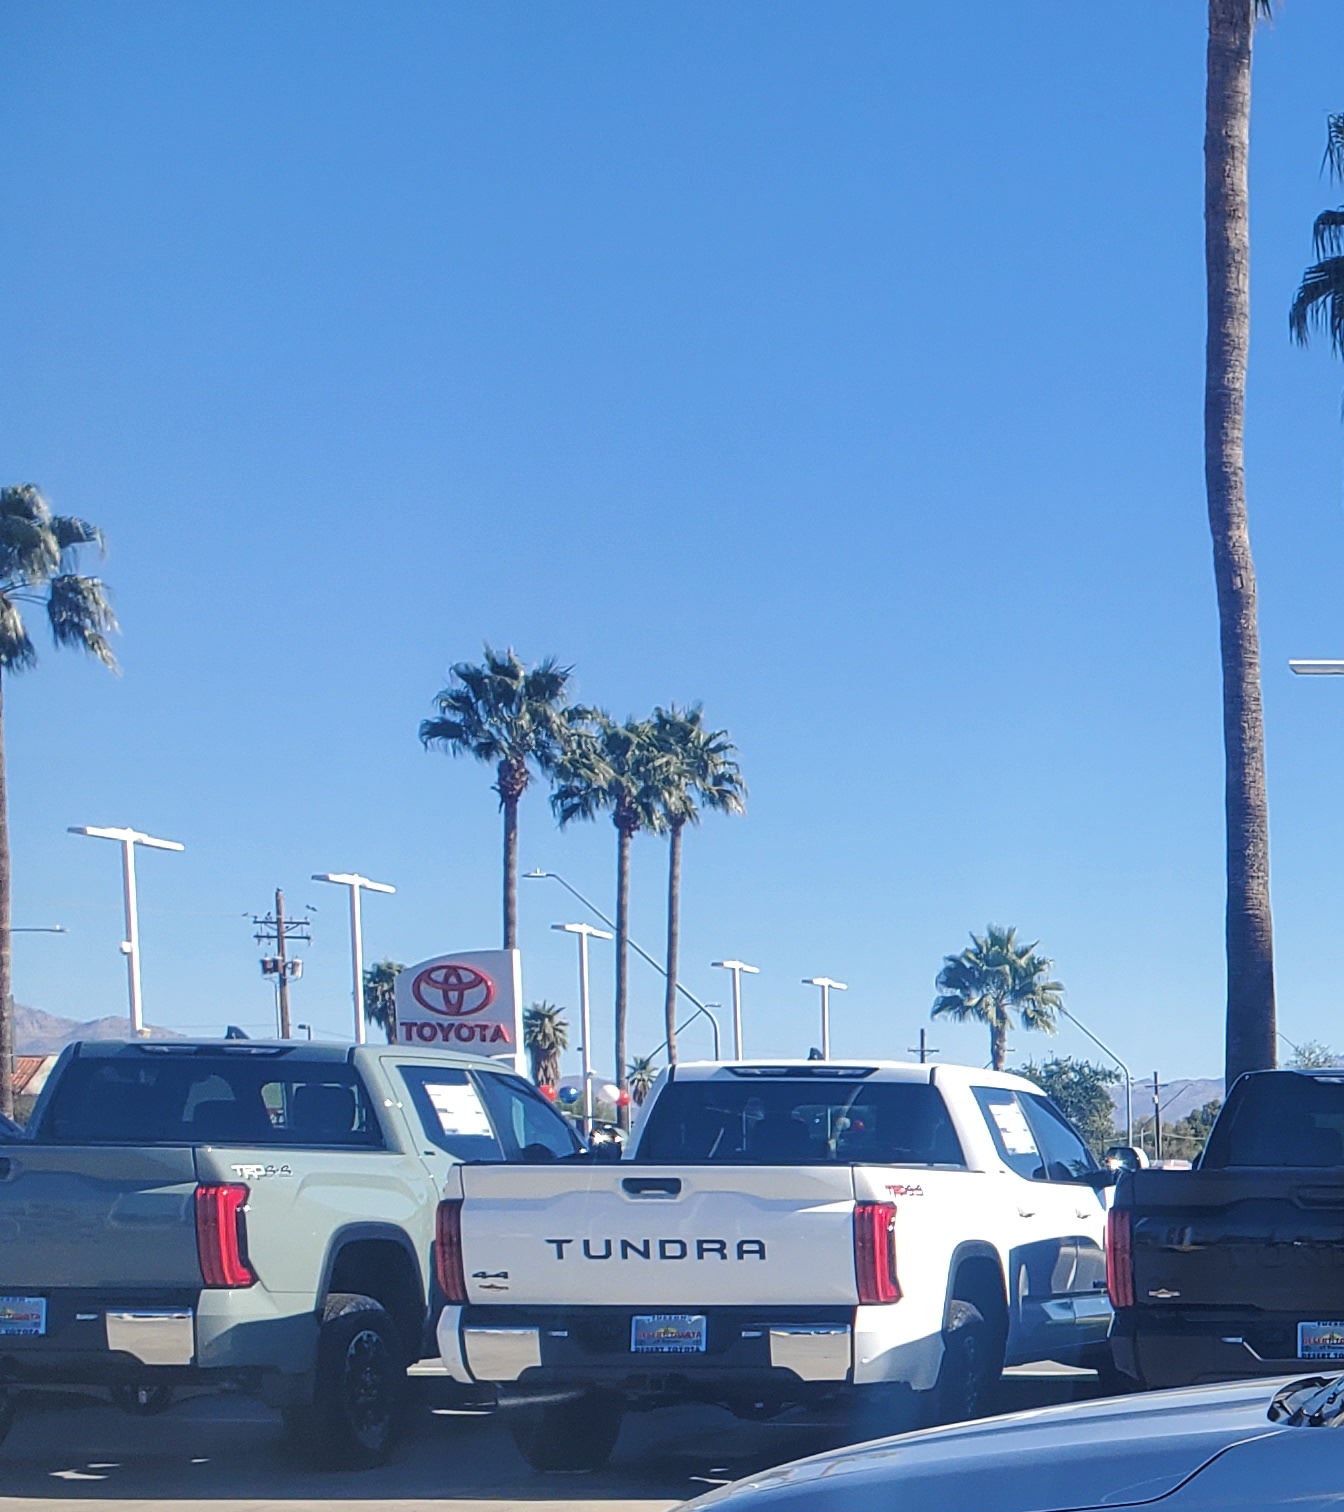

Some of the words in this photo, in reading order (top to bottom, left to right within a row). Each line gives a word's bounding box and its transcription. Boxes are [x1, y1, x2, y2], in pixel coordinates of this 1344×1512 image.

[400, 1022, 511, 1043] TOYOTA
[231, 1164, 266, 1180] TRD
[544, 1239, 767, 1261] TUNDRA
